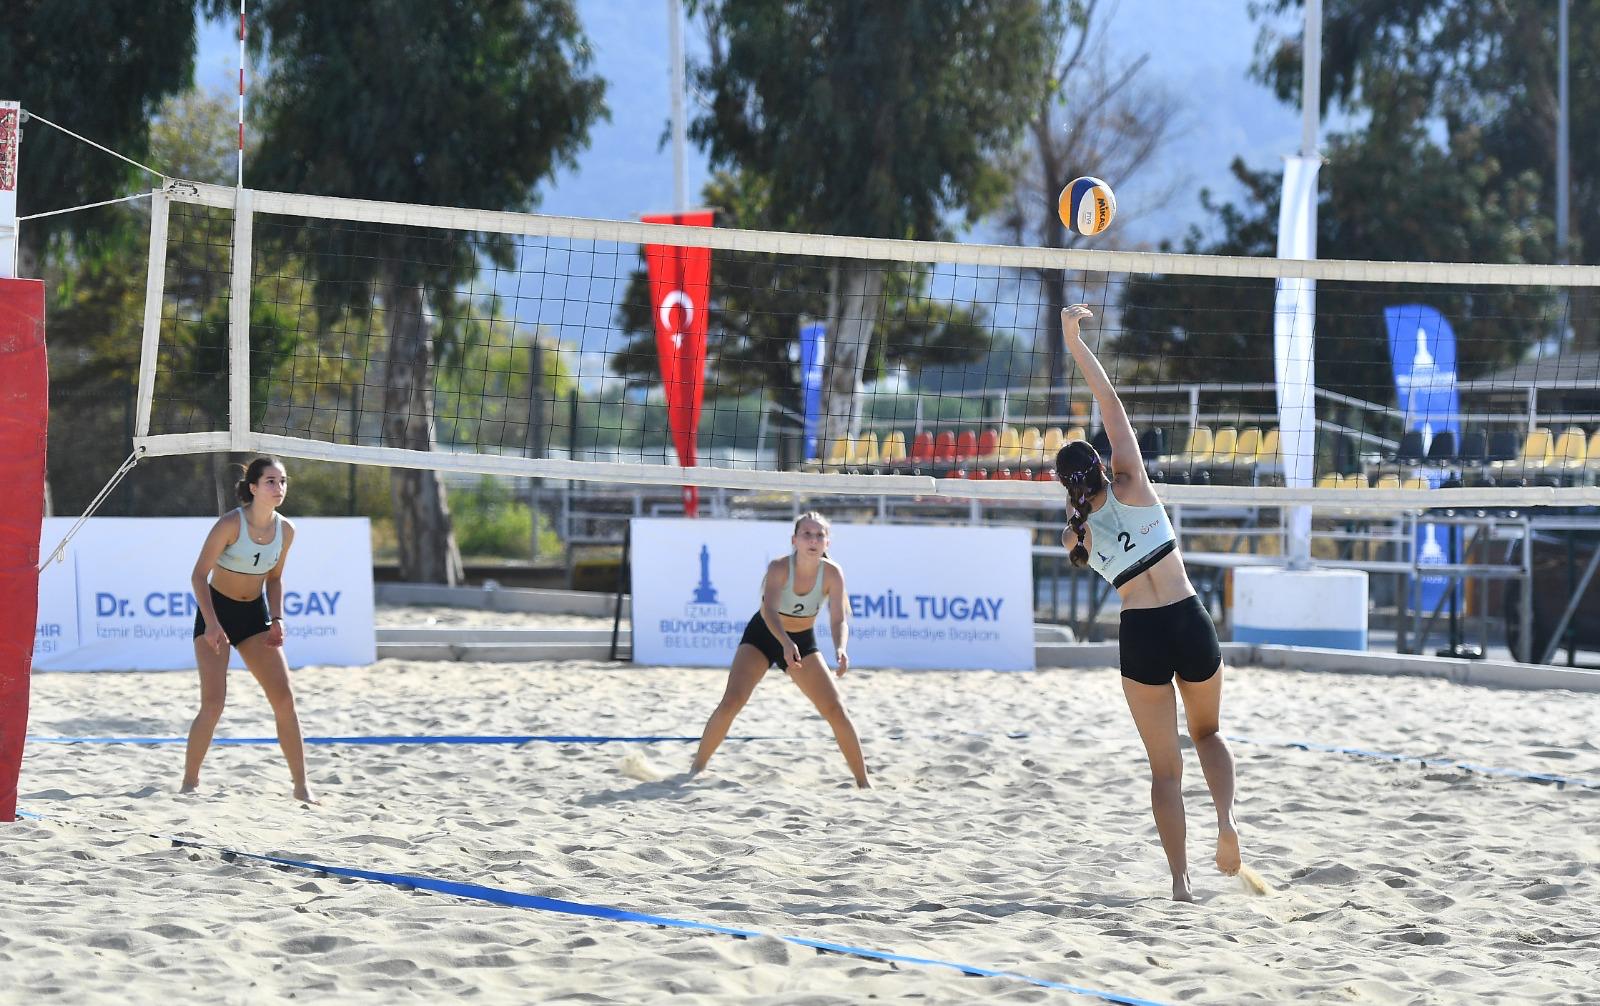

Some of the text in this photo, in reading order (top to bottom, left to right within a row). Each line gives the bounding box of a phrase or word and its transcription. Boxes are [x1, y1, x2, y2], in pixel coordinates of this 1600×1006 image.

[1118, 531, 1136, 552] 2
[253, 552, 261, 566] 1
[95, 591, 341, 617] Dr. CEM GAY
[792, 603, 804, 615] 2
[848, 589, 1004, 622] EMİL TUGAY
[96, 624, 130, 639] İzmir
[133, 623, 193, 641] Büyükşe
[659, 617, 747, 634] BÜYÜKŞEHİ
[816, 624, 1000, 643] Bükşehir Belediye Başkanı
[664, 634, 740, 649] BELEDİYE
